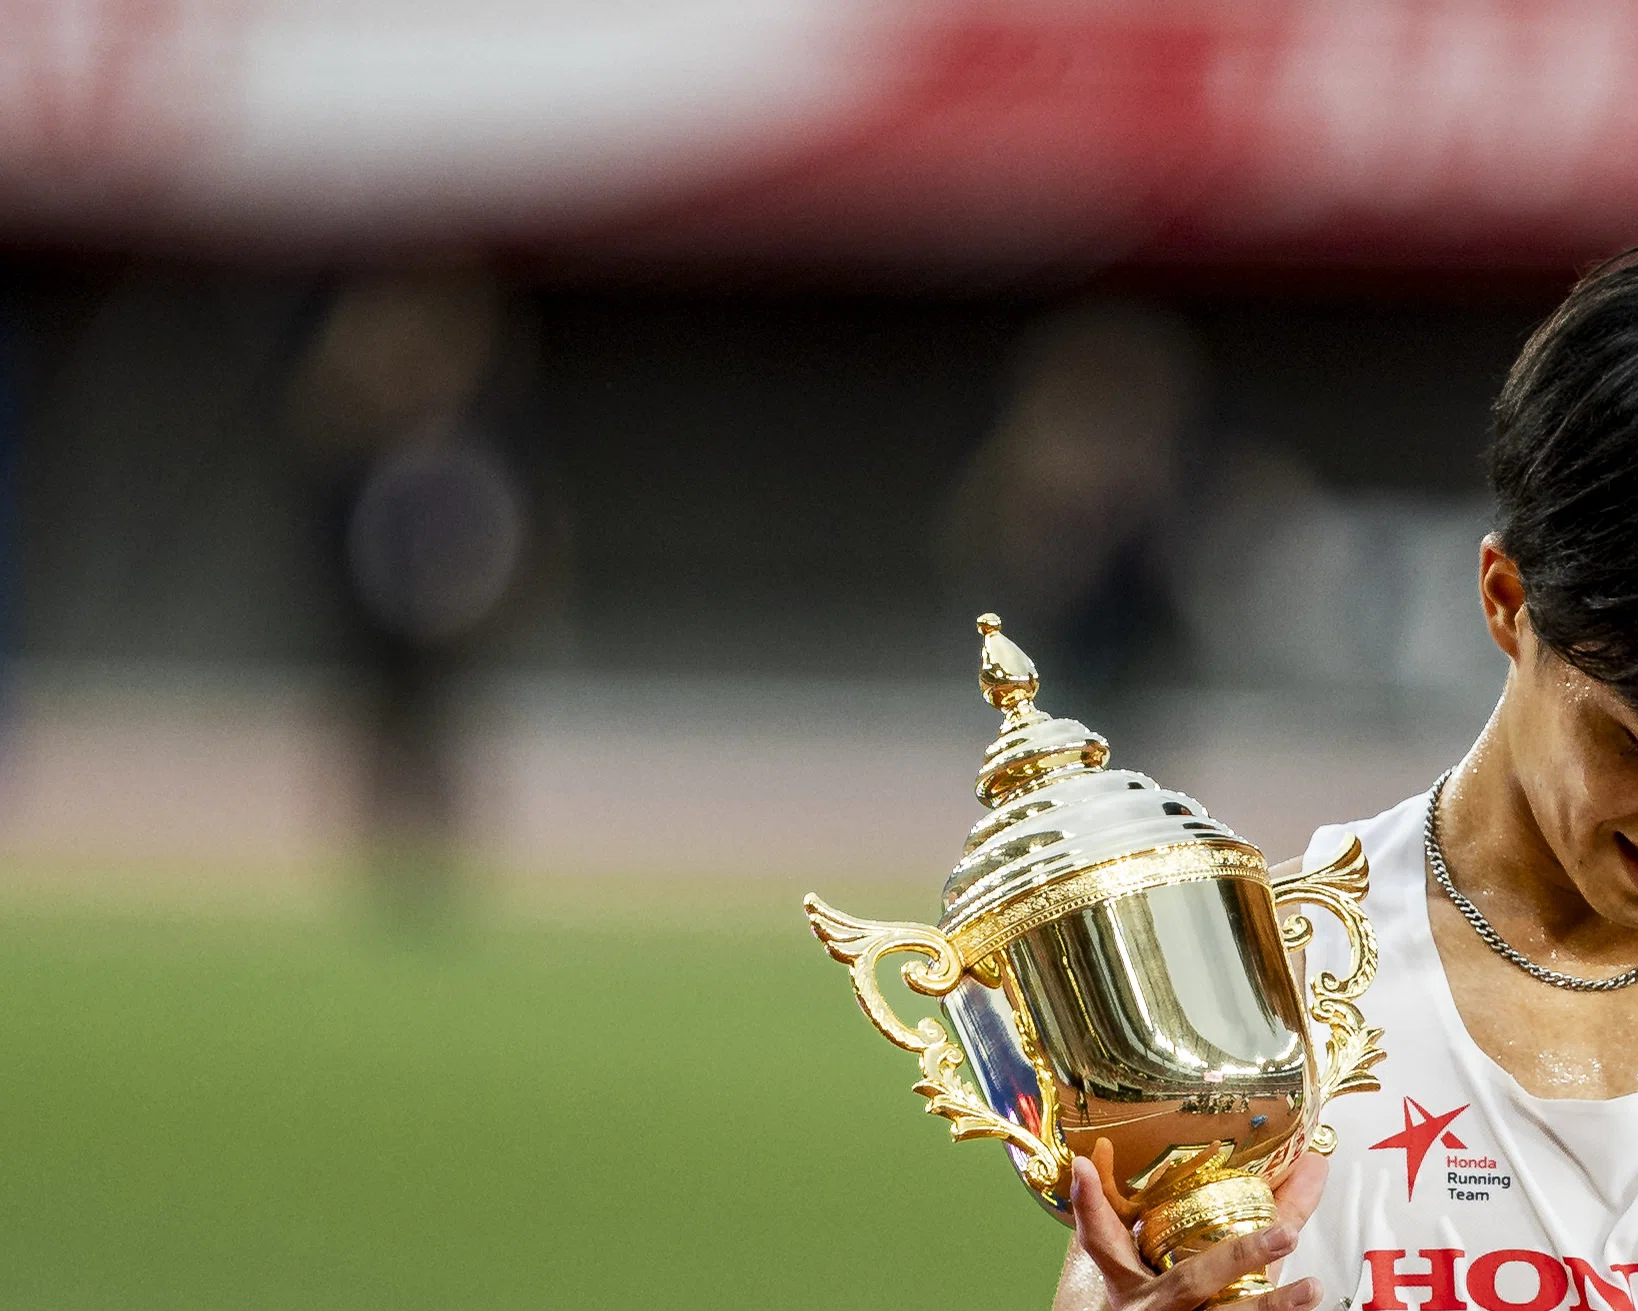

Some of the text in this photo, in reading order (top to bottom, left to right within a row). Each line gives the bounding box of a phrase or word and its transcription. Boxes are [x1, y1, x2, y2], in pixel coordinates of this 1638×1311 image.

[1447, 1155, 1497, 1169] Honda
[1447, 1171, 1511, 1189] Running
[1447, 1188, 1490, 1201] Team
